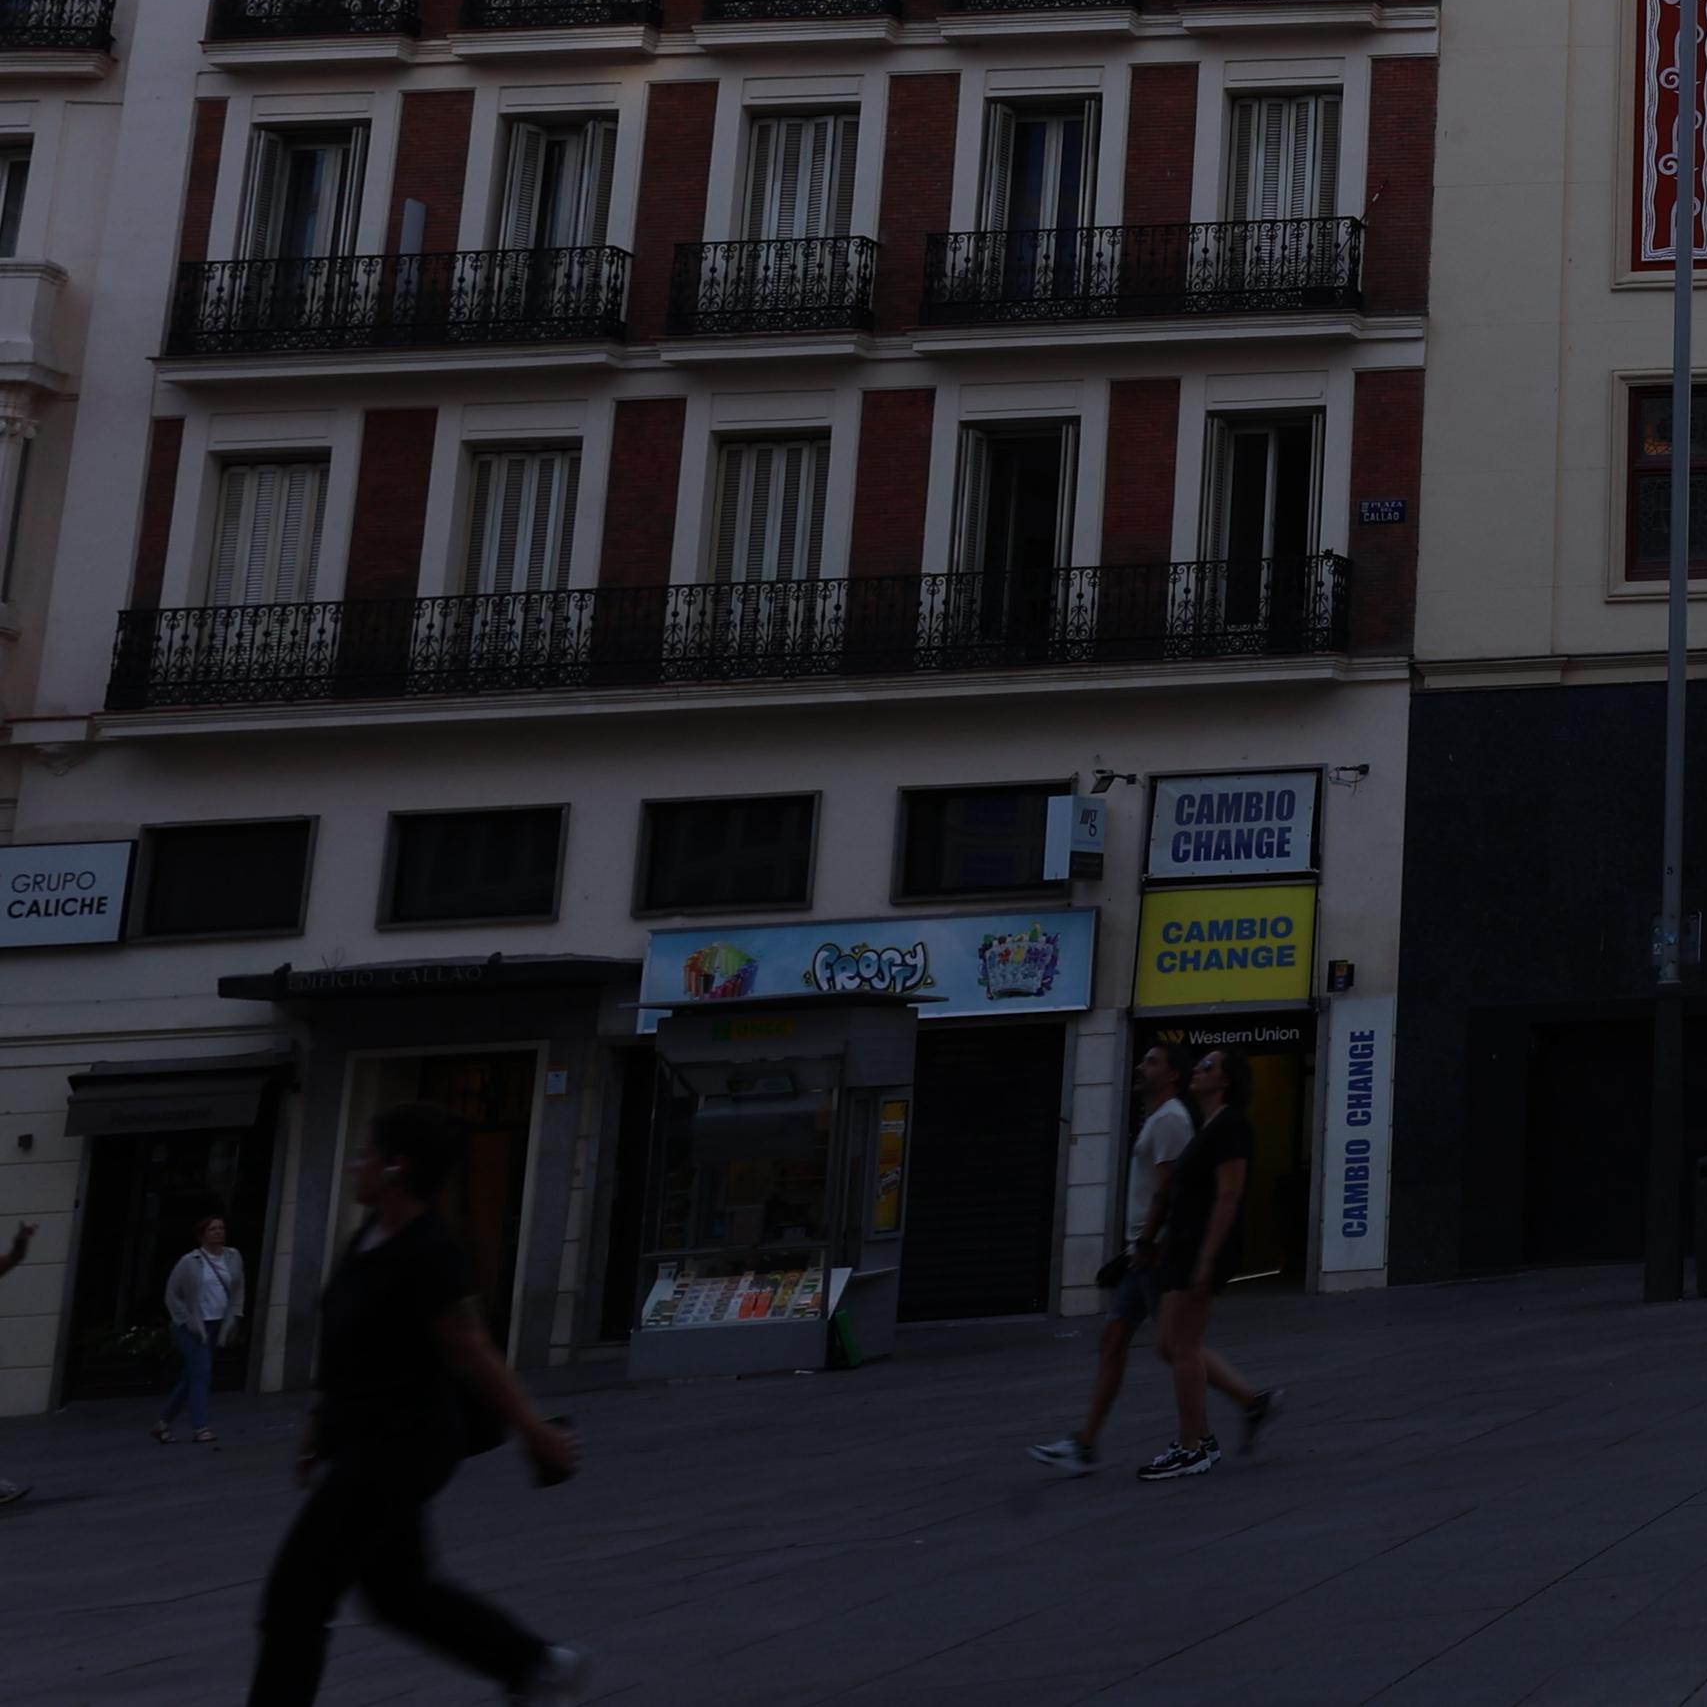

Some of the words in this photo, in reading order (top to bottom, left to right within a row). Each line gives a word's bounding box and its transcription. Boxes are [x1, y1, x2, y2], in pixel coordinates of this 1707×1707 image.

[1363, 512, 1401, 523] CALLAO
[1370, 500, 1403, 509] PLAZA
[1174, 789, 1297, 826] CAMBIO
[1171, 826, 1293, 863] CHANGE
[11, 870, 97, 894] GRUPO
[7, 896, 109, 919] CALICHE
[1162, 915, 1294, 945] CAMBIO
[1156, 944, 1297, 974] CHANGE
[288, 970, 375, 990] EDIFICIO
[391, 965, 482, 986] CALLAO
[1188, 1029, 1253, 1045] Western
[1254, 1025, 1300, 1043] Union
[1346, 1029, 1375, 1127] CHANGE
[1342, 1139, 1372, 1238] CAMBIO
